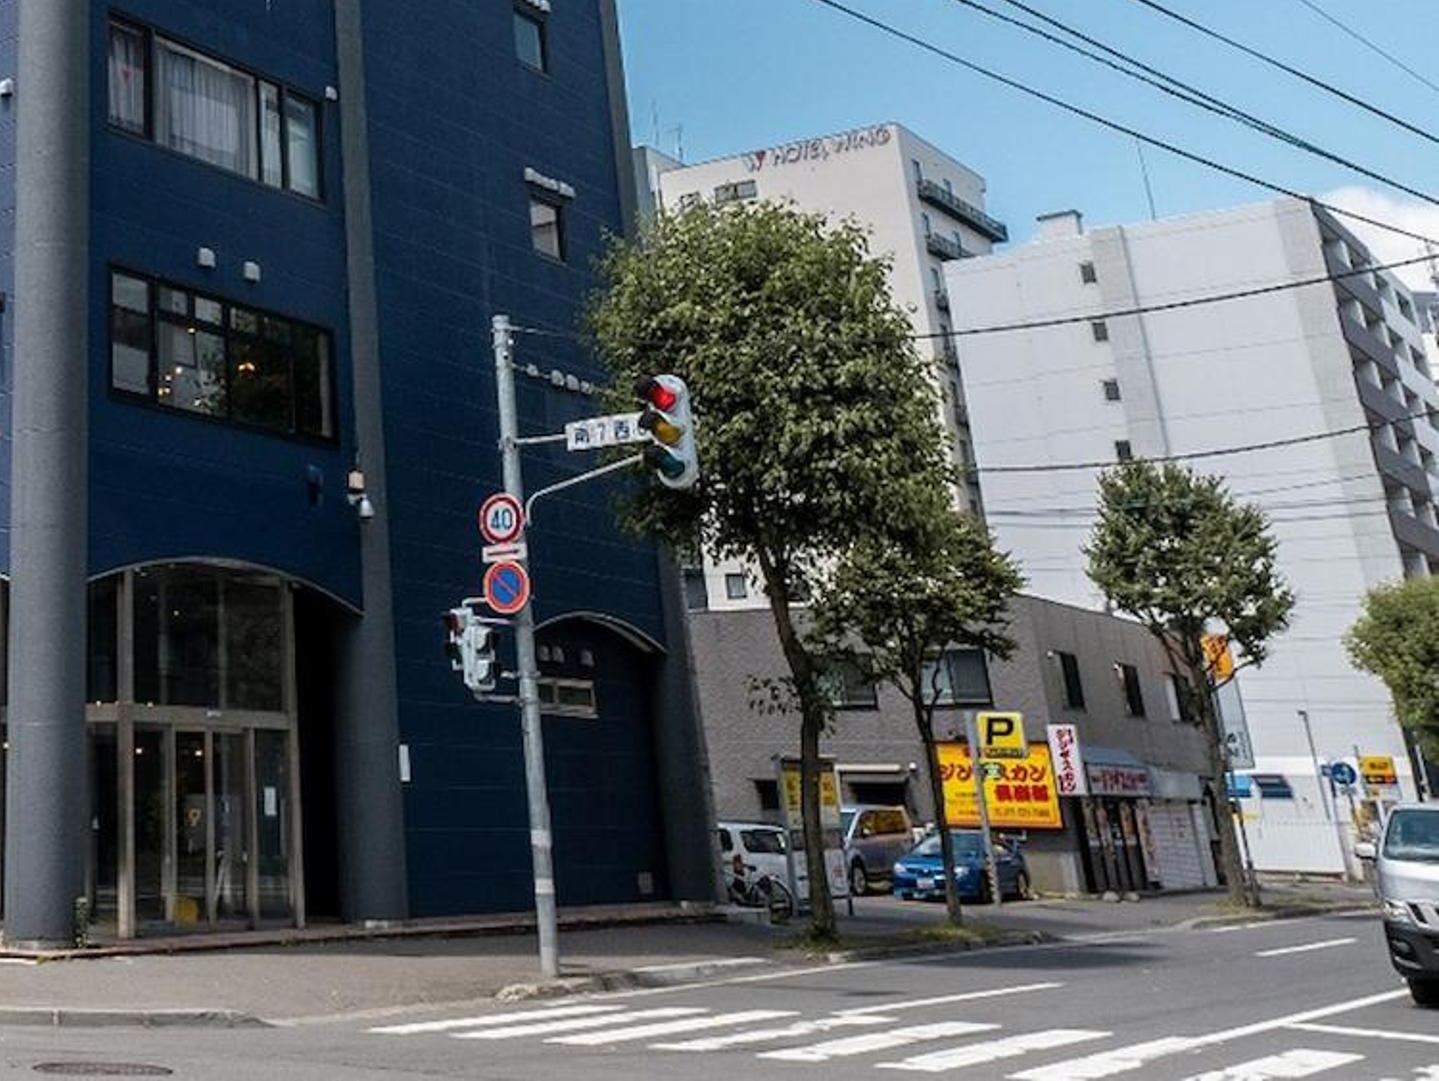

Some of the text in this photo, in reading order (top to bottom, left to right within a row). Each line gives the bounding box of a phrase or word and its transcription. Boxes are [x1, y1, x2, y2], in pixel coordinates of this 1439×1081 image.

[772, 127, 891, 166] HOTEL WING
[490, 507, 513, 530] 40
[985, 717, 1014, 746] P
